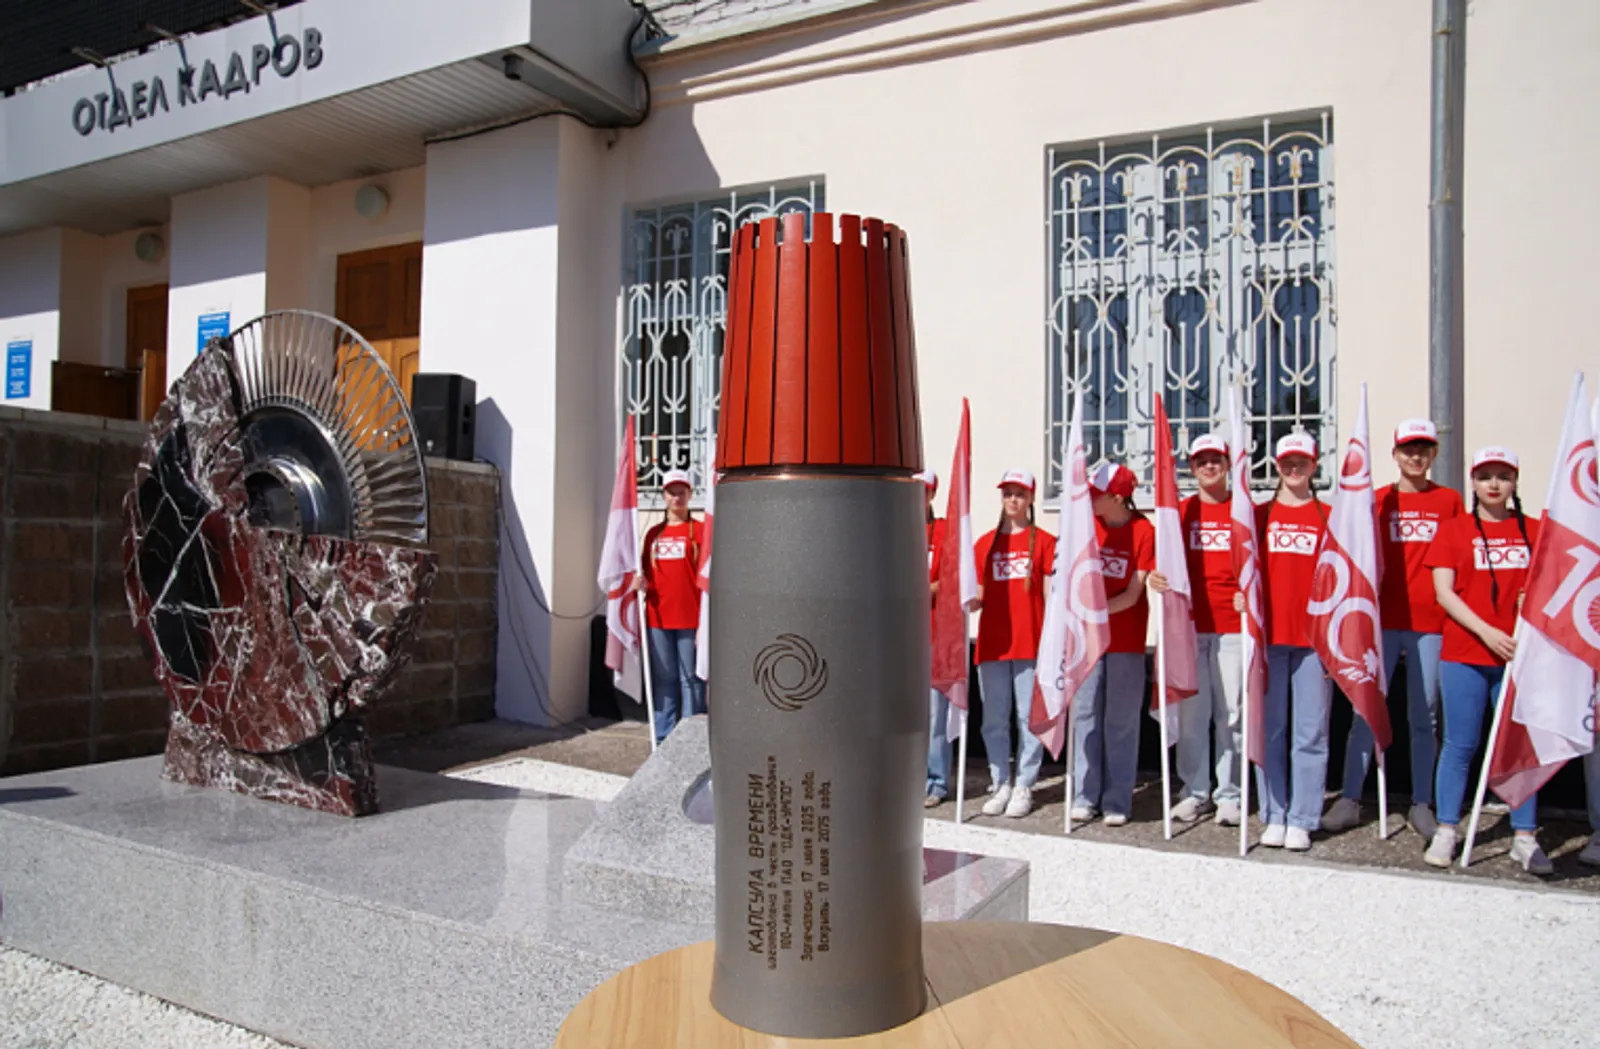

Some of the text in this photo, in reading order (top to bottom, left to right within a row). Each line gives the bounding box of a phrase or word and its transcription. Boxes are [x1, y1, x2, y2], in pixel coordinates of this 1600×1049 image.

[72, 27, 324, 137] ОТДЕЛ КАДРОВ
[801, 804, 813, 833] 2025
[818, 815, 830, 843] 2075
[748, 773, 764, 954] КАПСУЛА ВРЕМЕНИ
[780, 860, 793, 885] ПАО
[801, 870, 813, 883] 17
[818, 881, 829, 893] 17
